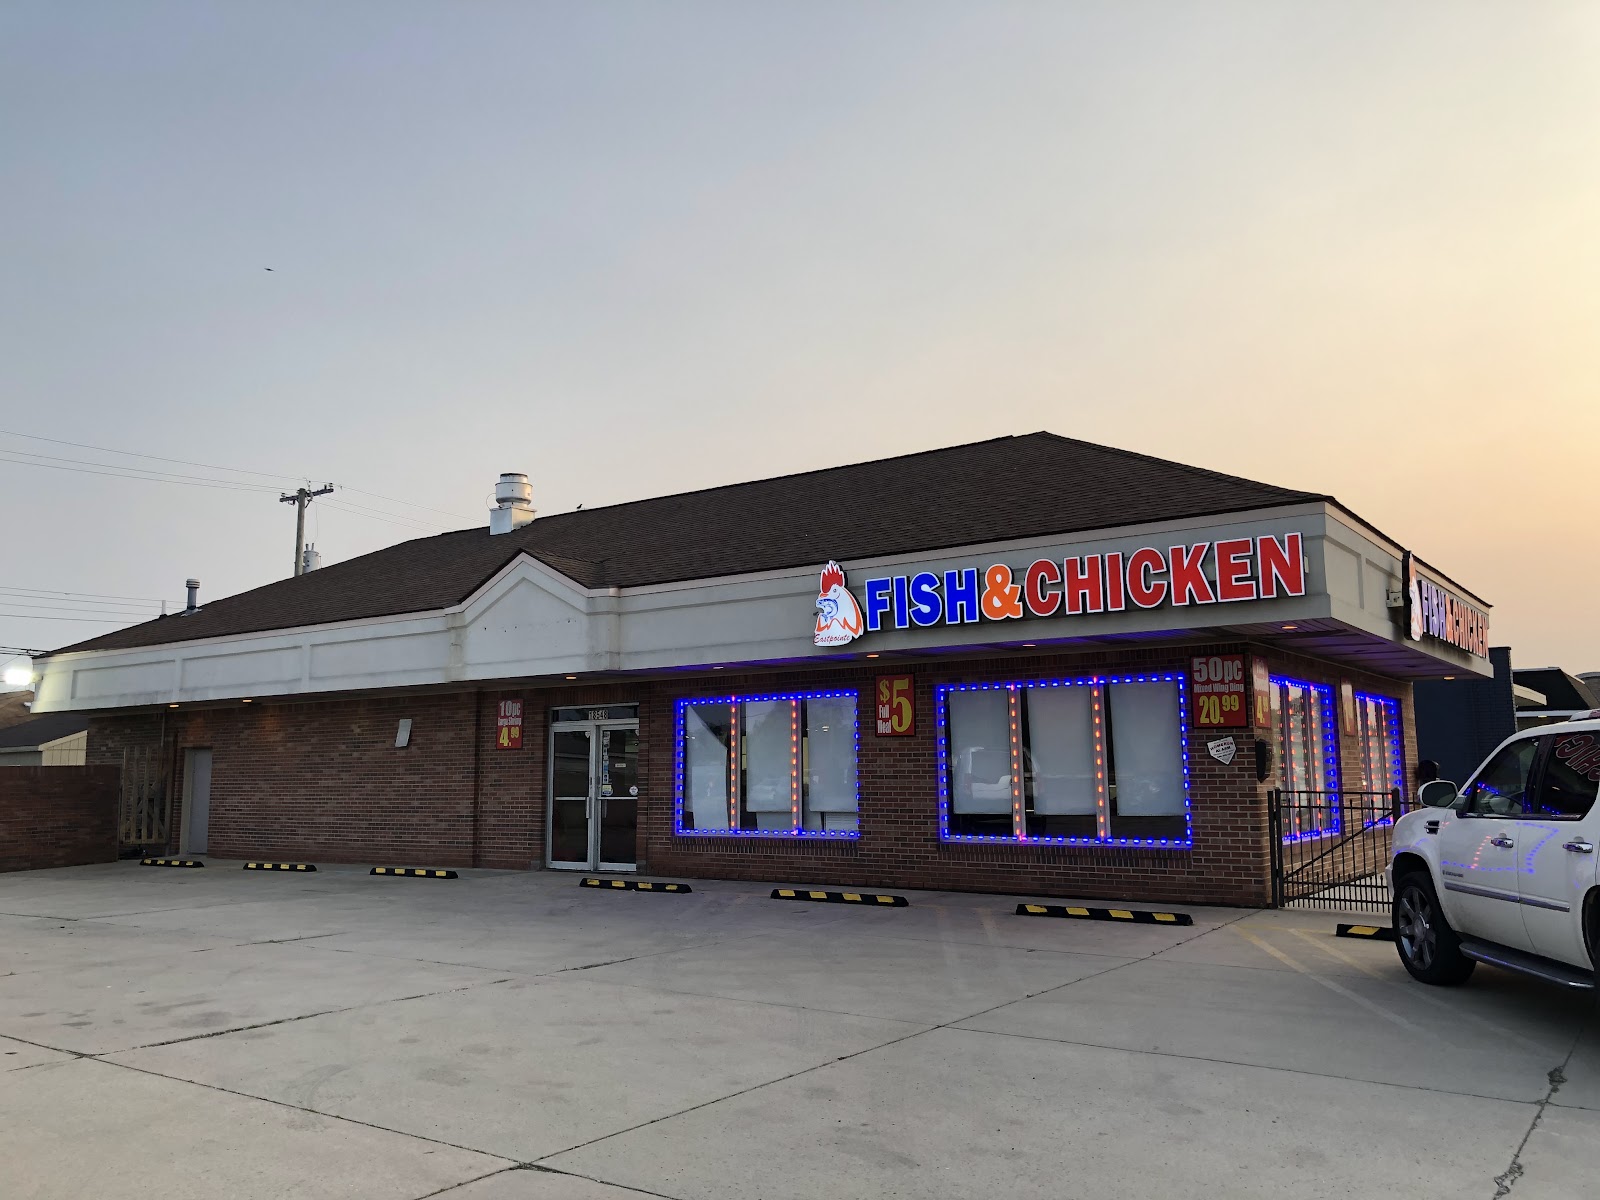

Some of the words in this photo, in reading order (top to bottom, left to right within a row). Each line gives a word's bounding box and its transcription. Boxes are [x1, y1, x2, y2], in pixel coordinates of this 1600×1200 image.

[814, 633, 851, 644] Eastpointe
[1213, 682, 1229, 693] Wing
[1230, 682, 1244, 692] Ding
[878, 704, 889, 718] Full
[1198, 694, 1239, 724] 20.99
[877, 719, 891, 734] Meal
